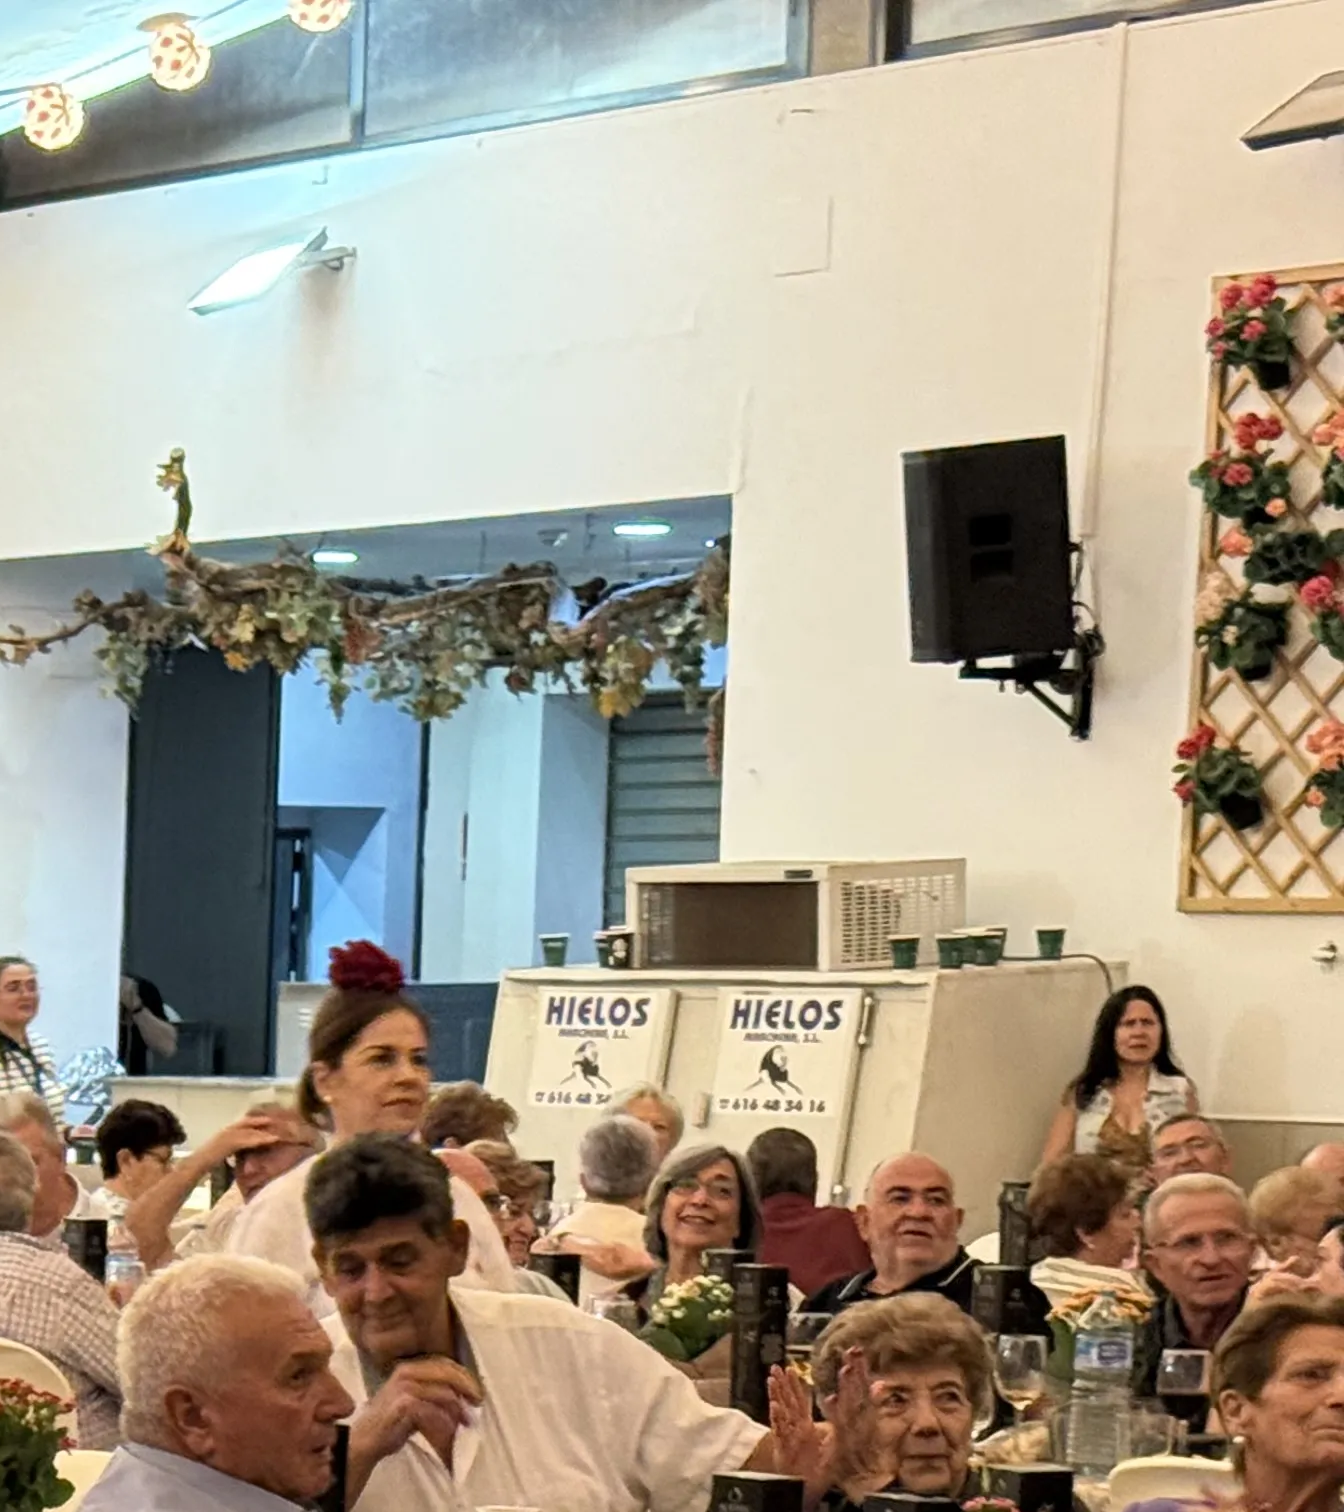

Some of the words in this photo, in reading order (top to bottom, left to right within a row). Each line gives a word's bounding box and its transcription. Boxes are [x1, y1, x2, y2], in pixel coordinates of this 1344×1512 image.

[545, 996, 652, 1027] HIELOS
[729, 999, 845, 1030] HIELOS
[547, 1091, 572, 1104] 616
[732, 1098, 758, 1111] 616
[809, 1100, 826, 1113] 16
